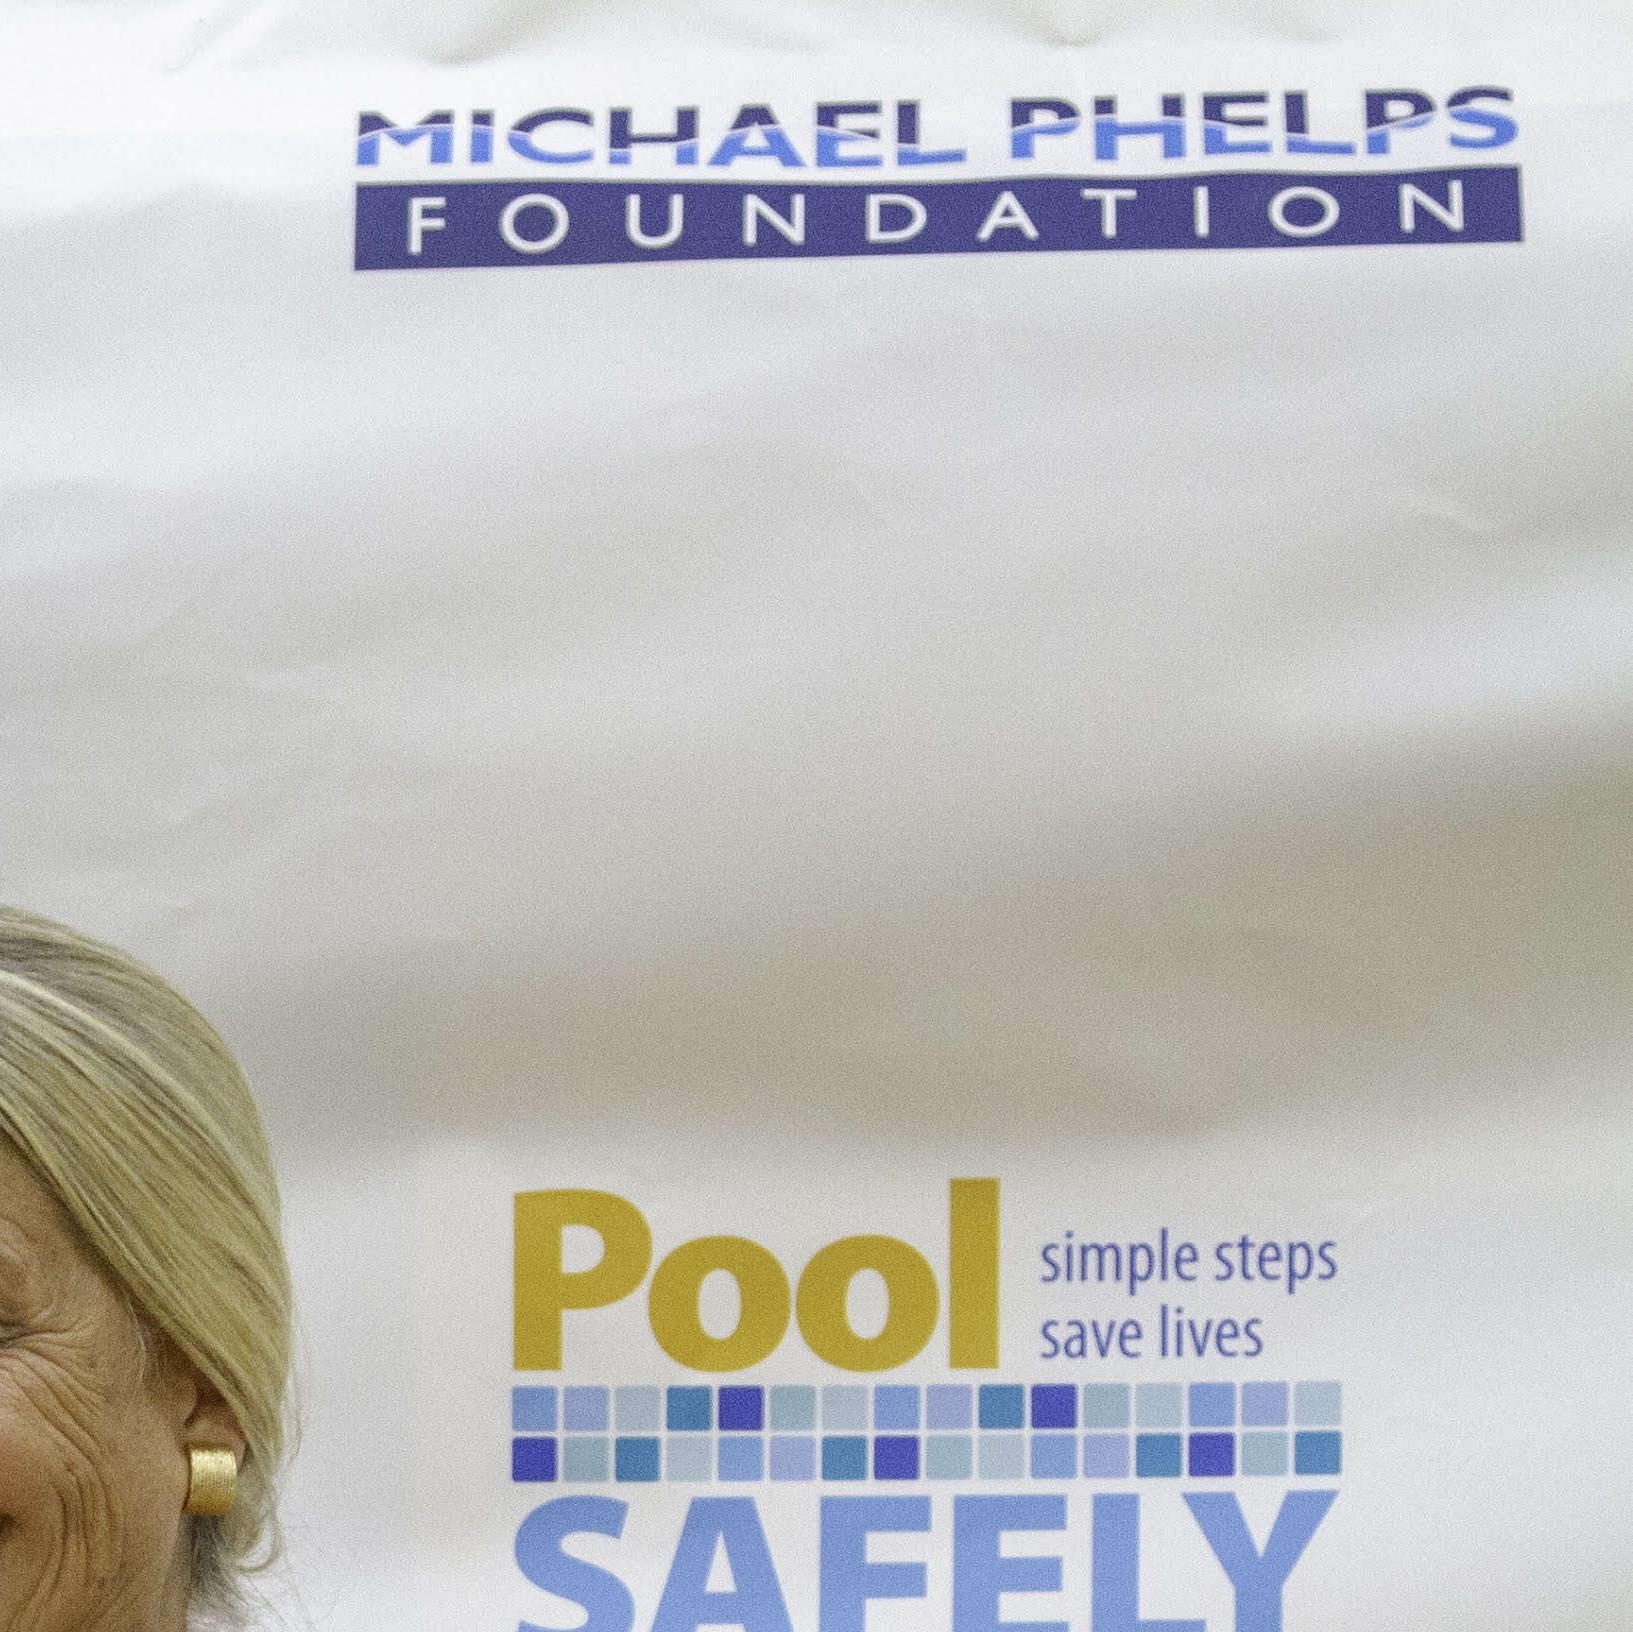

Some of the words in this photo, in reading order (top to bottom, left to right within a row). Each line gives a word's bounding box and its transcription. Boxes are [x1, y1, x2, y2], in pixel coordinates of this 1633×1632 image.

[354, 97, 968, 169] MICHAEL
[1008, 85, 1520, 159] PHELPS
[406, 178, 1465, 255] FOUNDATION
[512, 1177, 1001, 1373] Pool
[1040, 1227, 1200, 1296] simple
[1213, 1234, 1338, 1295] steps
[1040, 1316, 1143, 1360] save
[1159, 1303, 1264, 1359] lives
